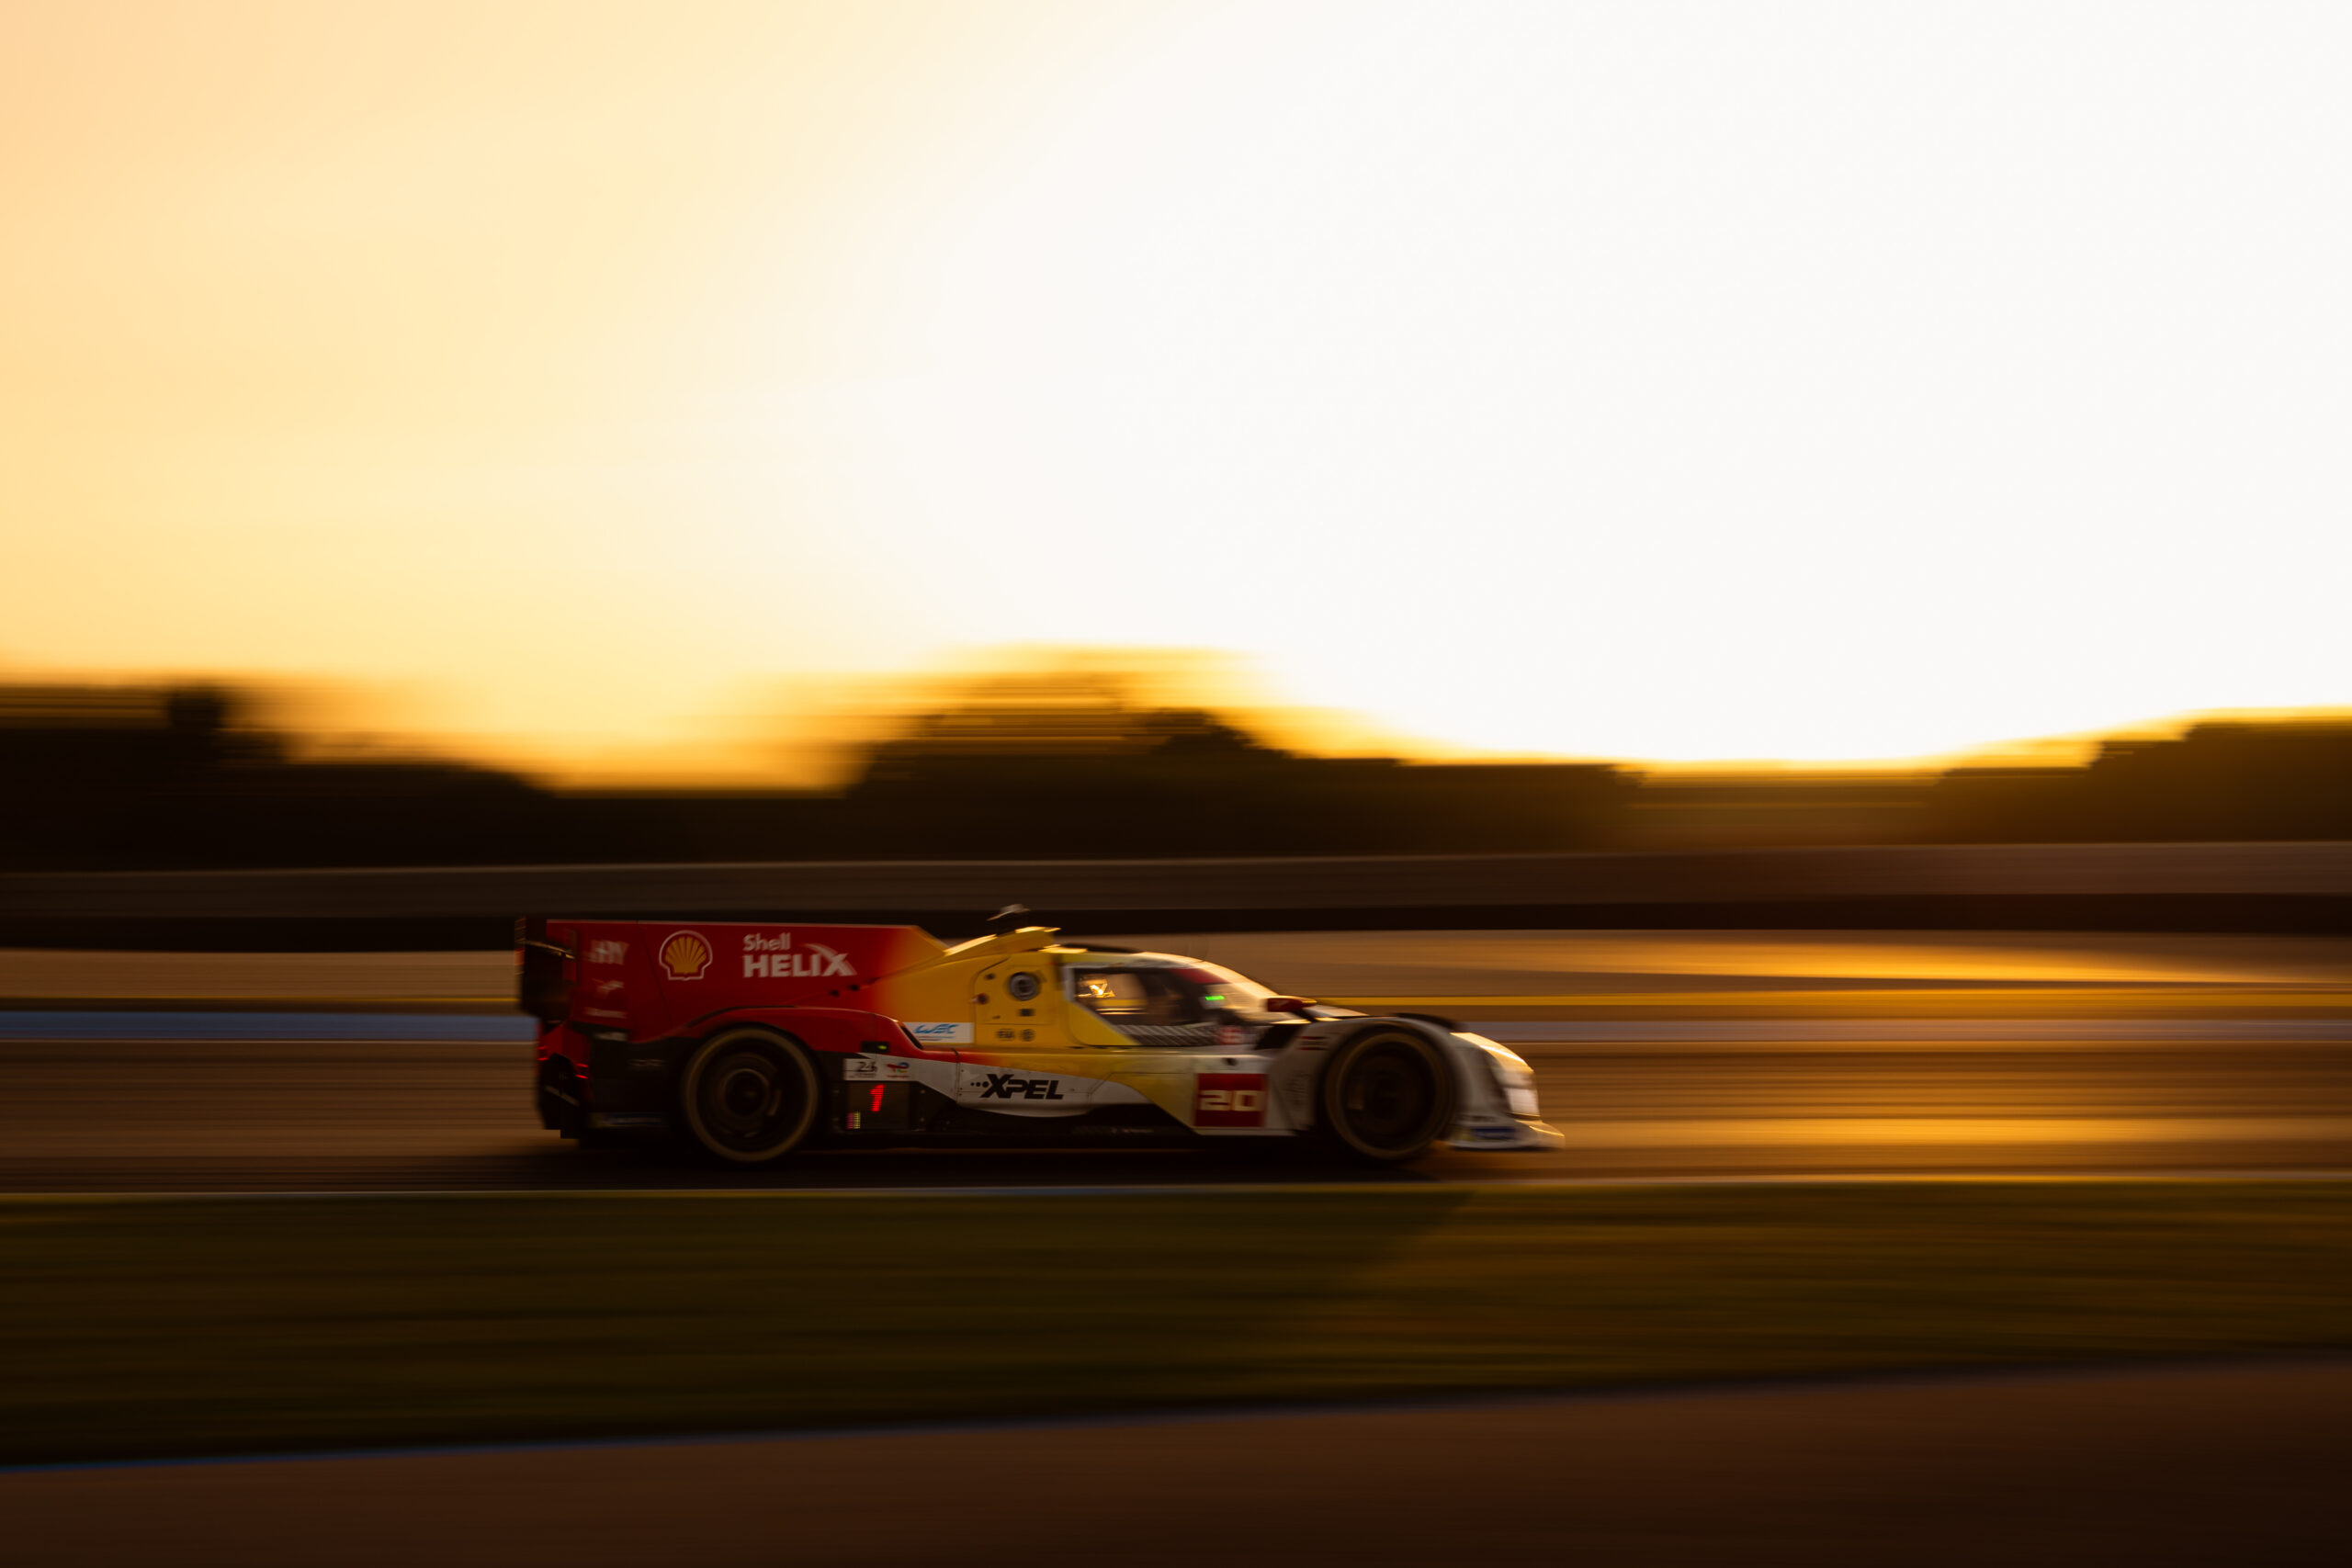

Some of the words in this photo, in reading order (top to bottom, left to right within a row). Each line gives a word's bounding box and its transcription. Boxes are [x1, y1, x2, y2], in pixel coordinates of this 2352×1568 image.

[742, 932, 791, 952] Shell
[742, 944, 858, 978] HELIX
[869, 1084, 885, 1112] 1
[979, 1074, 1064, 1100] XPEL
[1198, 1089, 1262, 1111] 20
